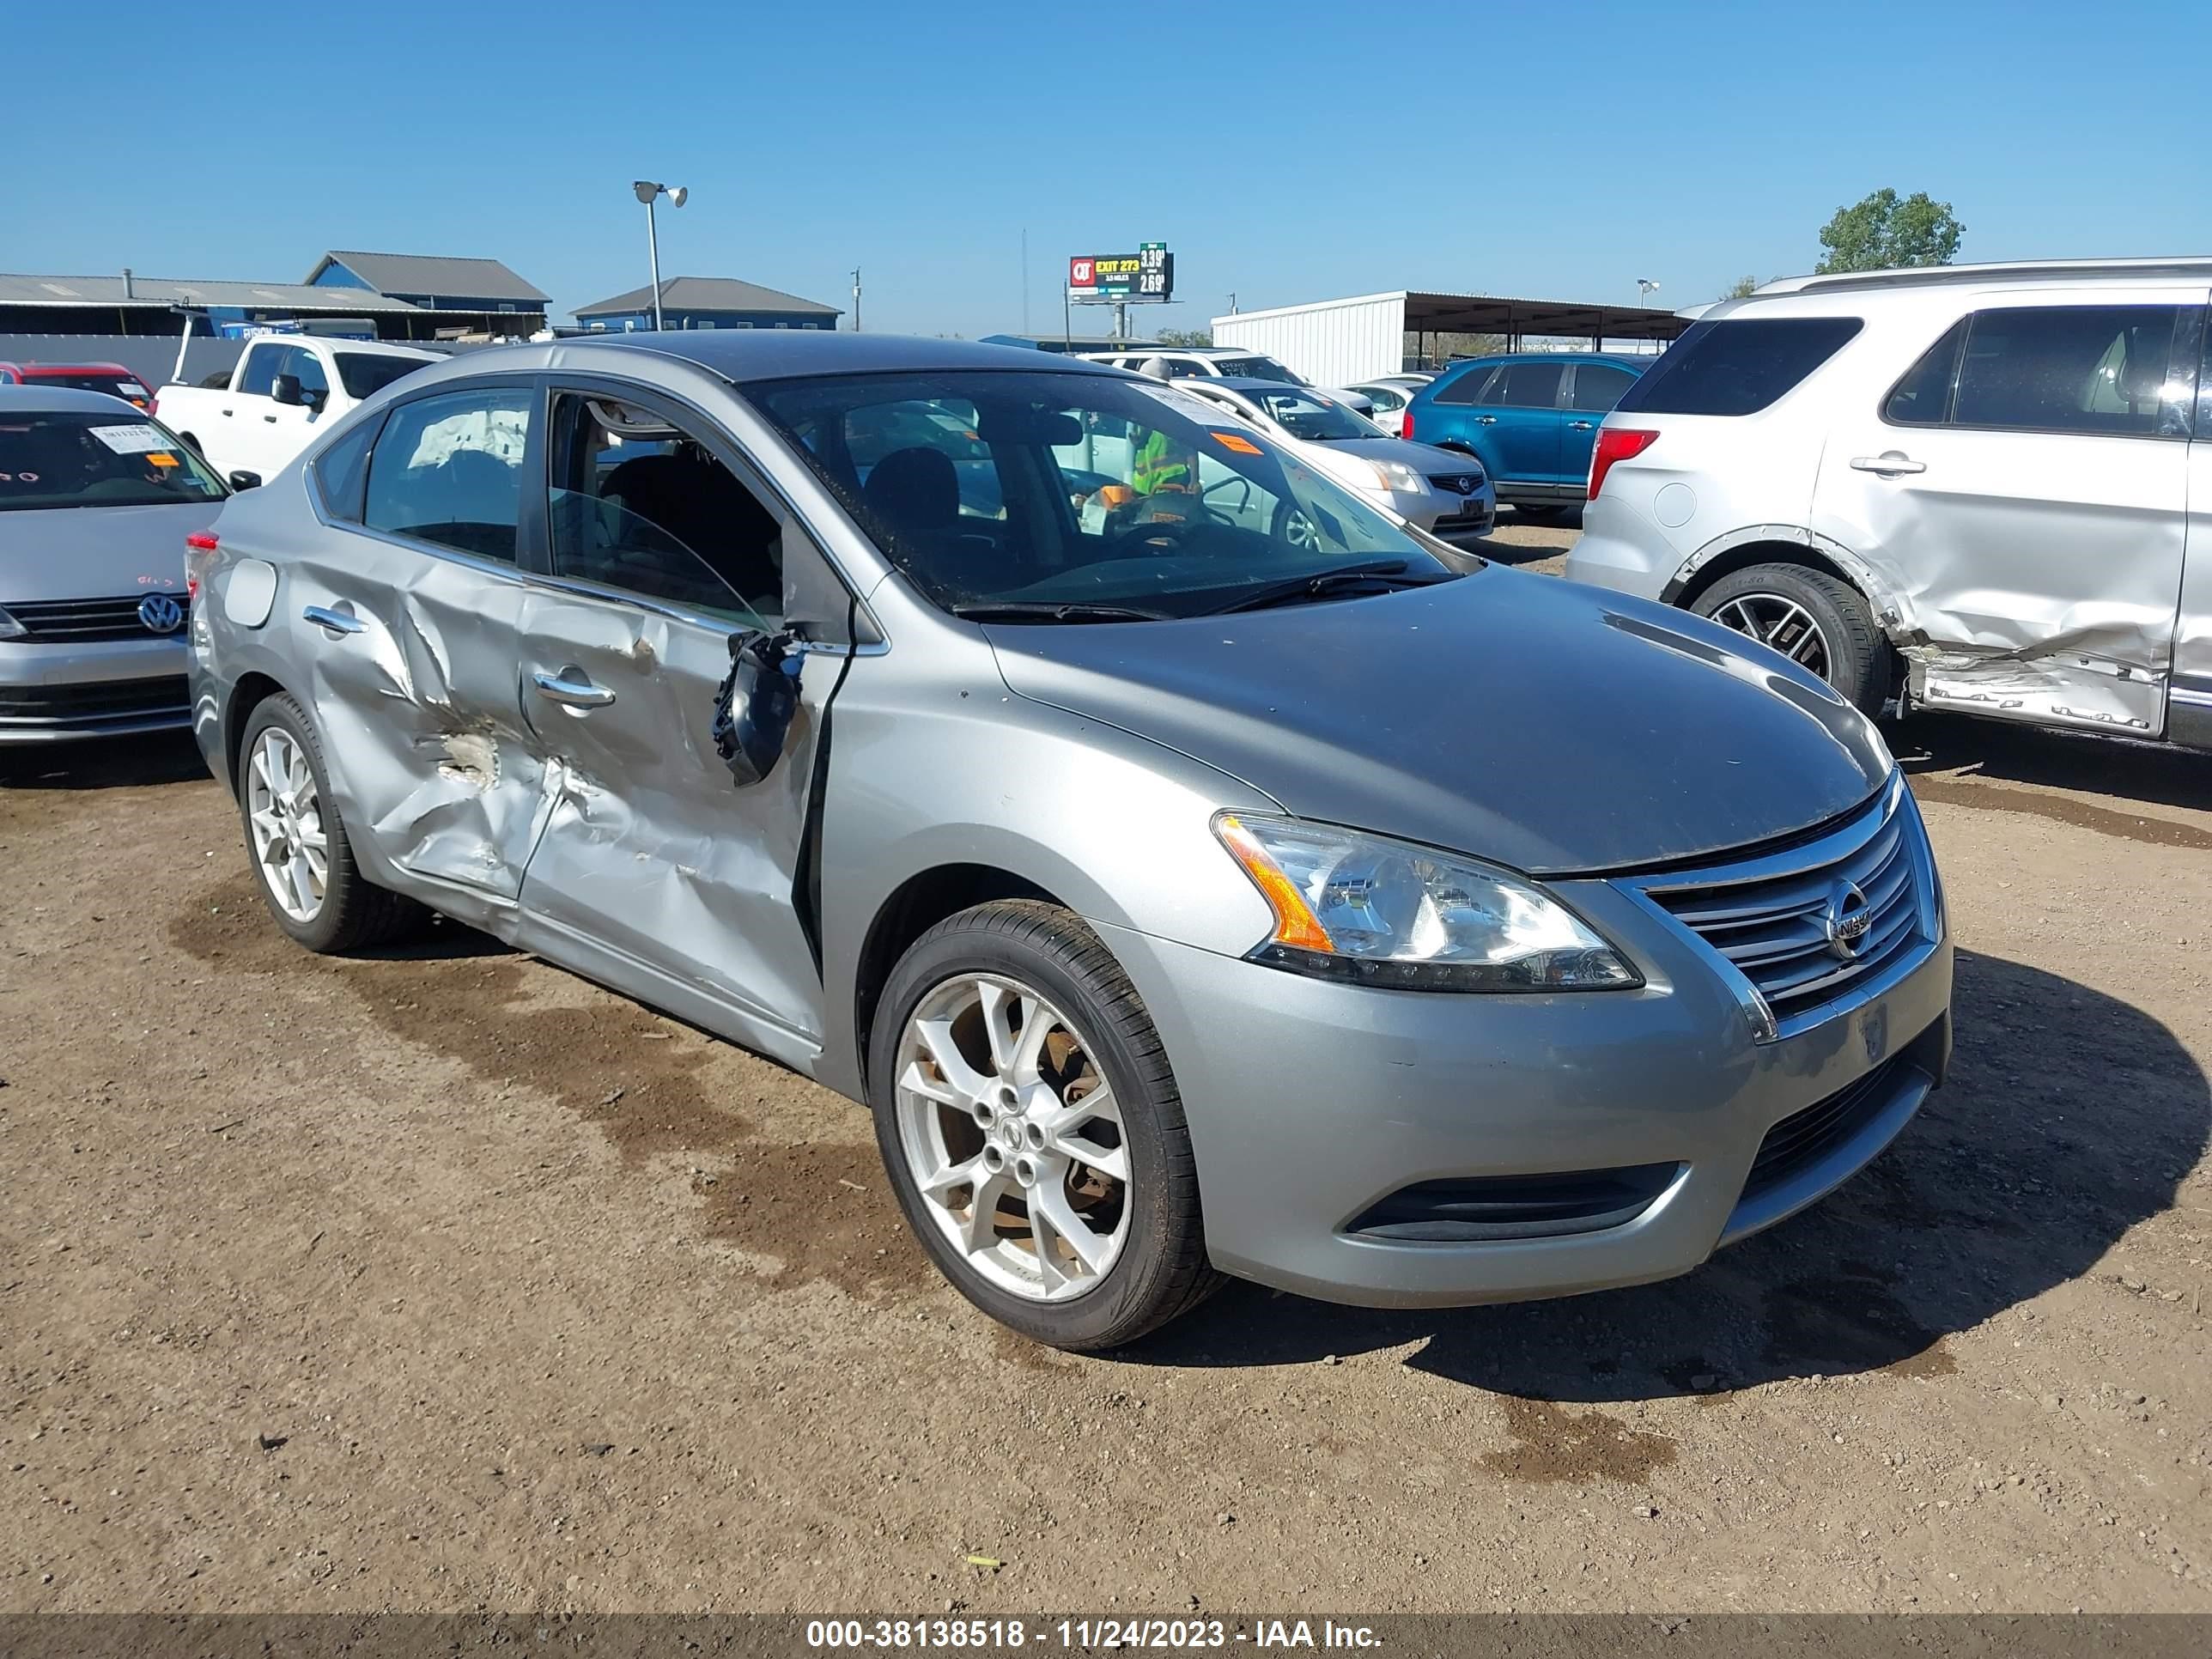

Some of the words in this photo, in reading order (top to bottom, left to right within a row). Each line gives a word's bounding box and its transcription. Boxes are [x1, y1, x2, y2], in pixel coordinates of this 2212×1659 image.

[1073, 262, 1091, 281] QT
[1096, 261, 1119, 272] EXIT
[1120, 260, 1139, 271] 273
[243, 326, 273, 339] FUSION
